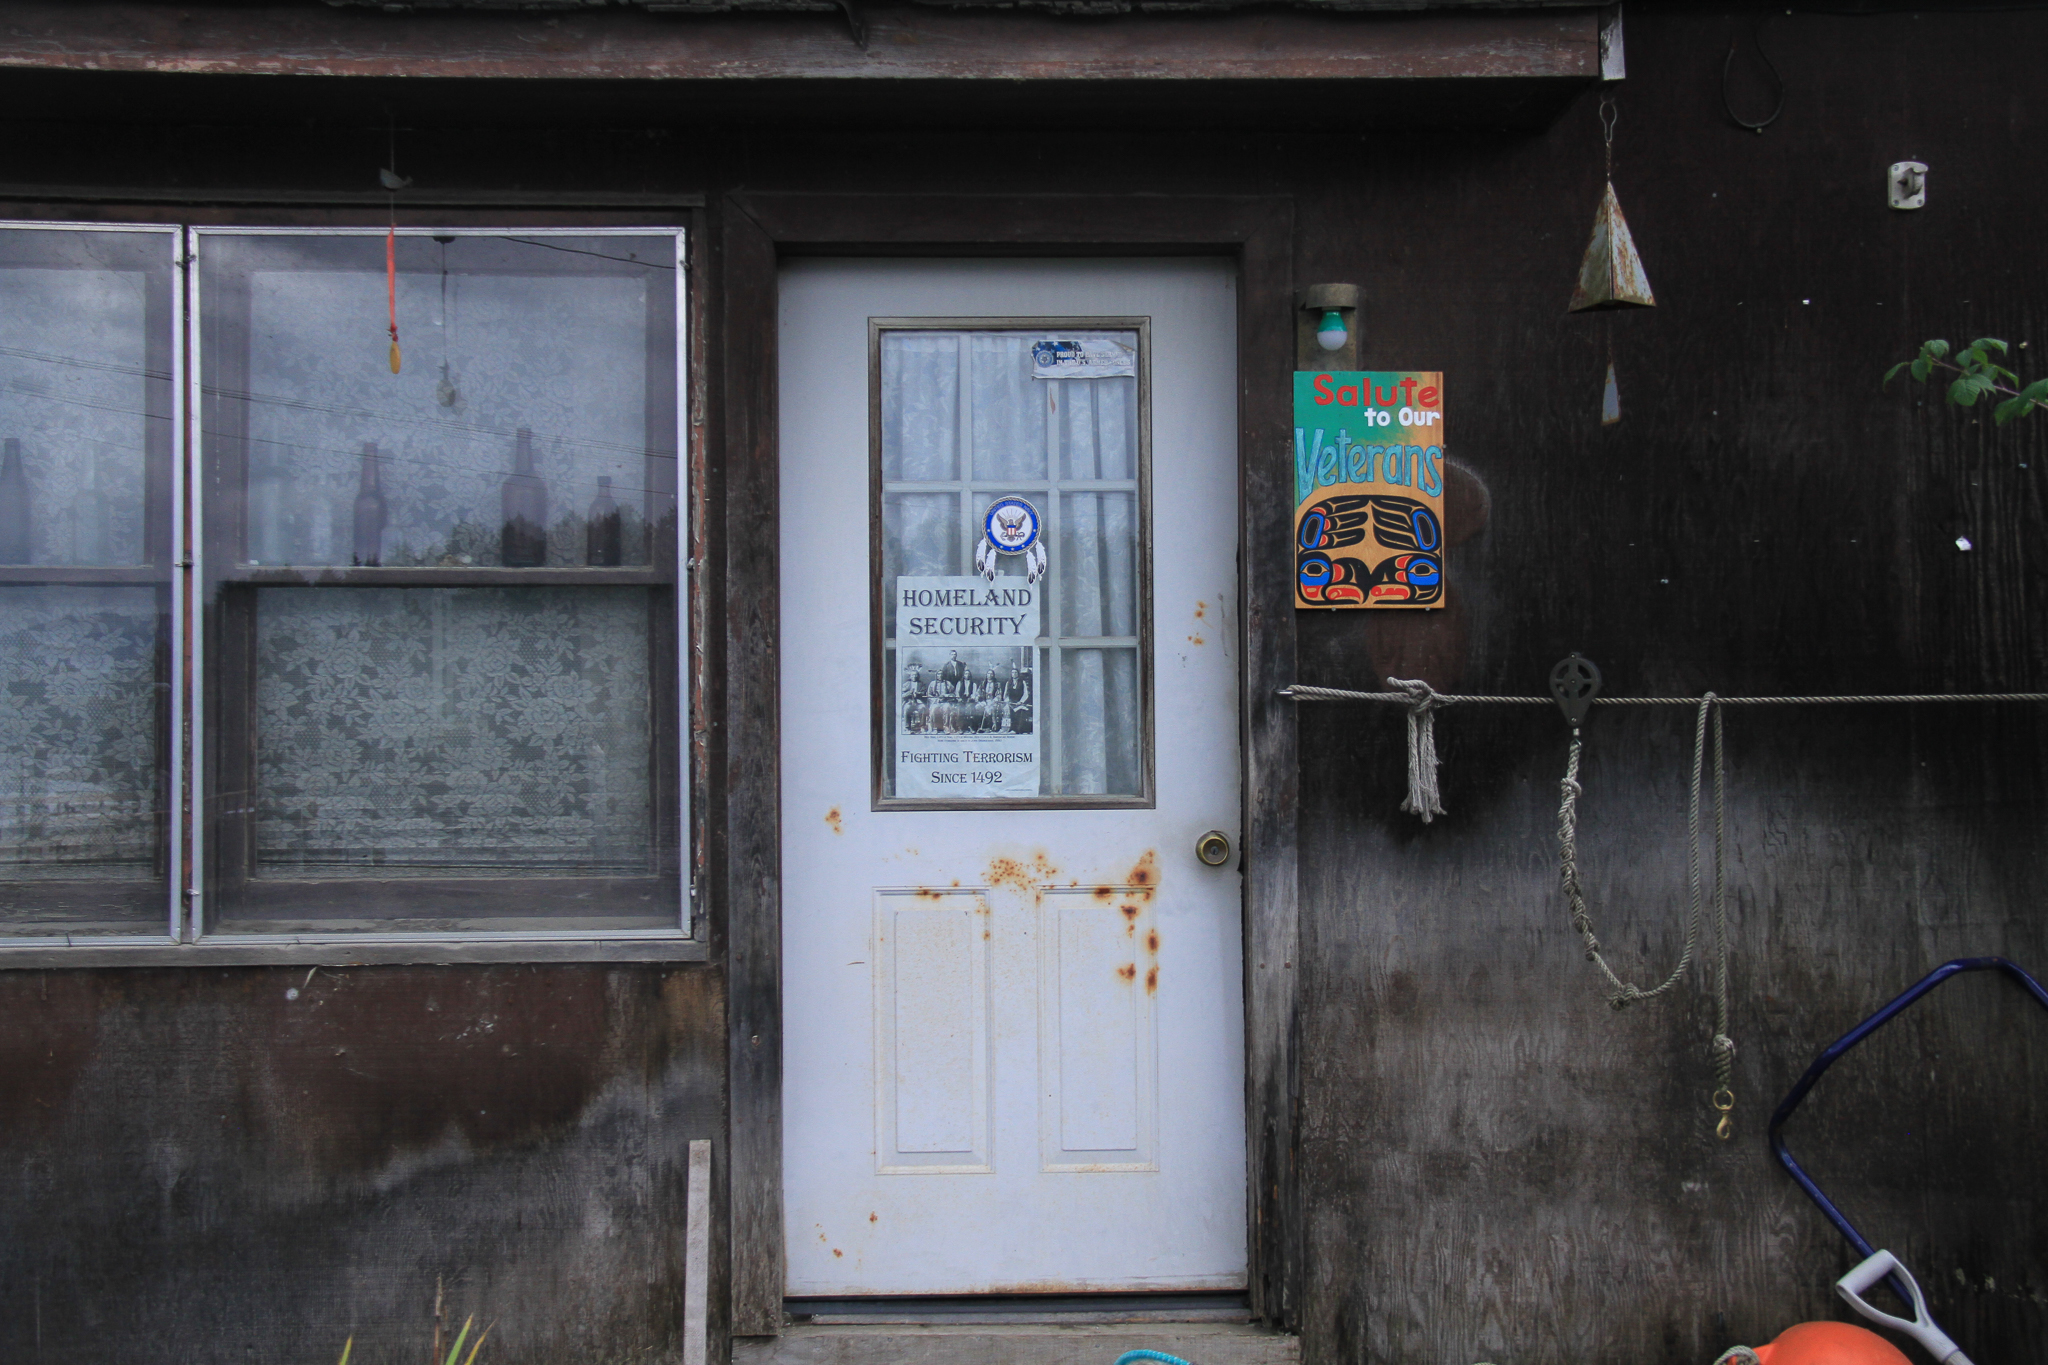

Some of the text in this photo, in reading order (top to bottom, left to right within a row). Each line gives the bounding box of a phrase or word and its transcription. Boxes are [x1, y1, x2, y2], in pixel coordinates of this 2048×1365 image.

[1313, 374, 1440, 408] Salute
[1364, 407, 1441, 427] to Our
[1295, 427, 1443, 506] Veterans
[902, 588, 1032, 607] HOMELAND
[909, 613, 1027, 635] SECURITY
[900, 750, 1033, 763] FIGHTING TERRORISM
[931, 770, 1003, 784] SINCE 1492
